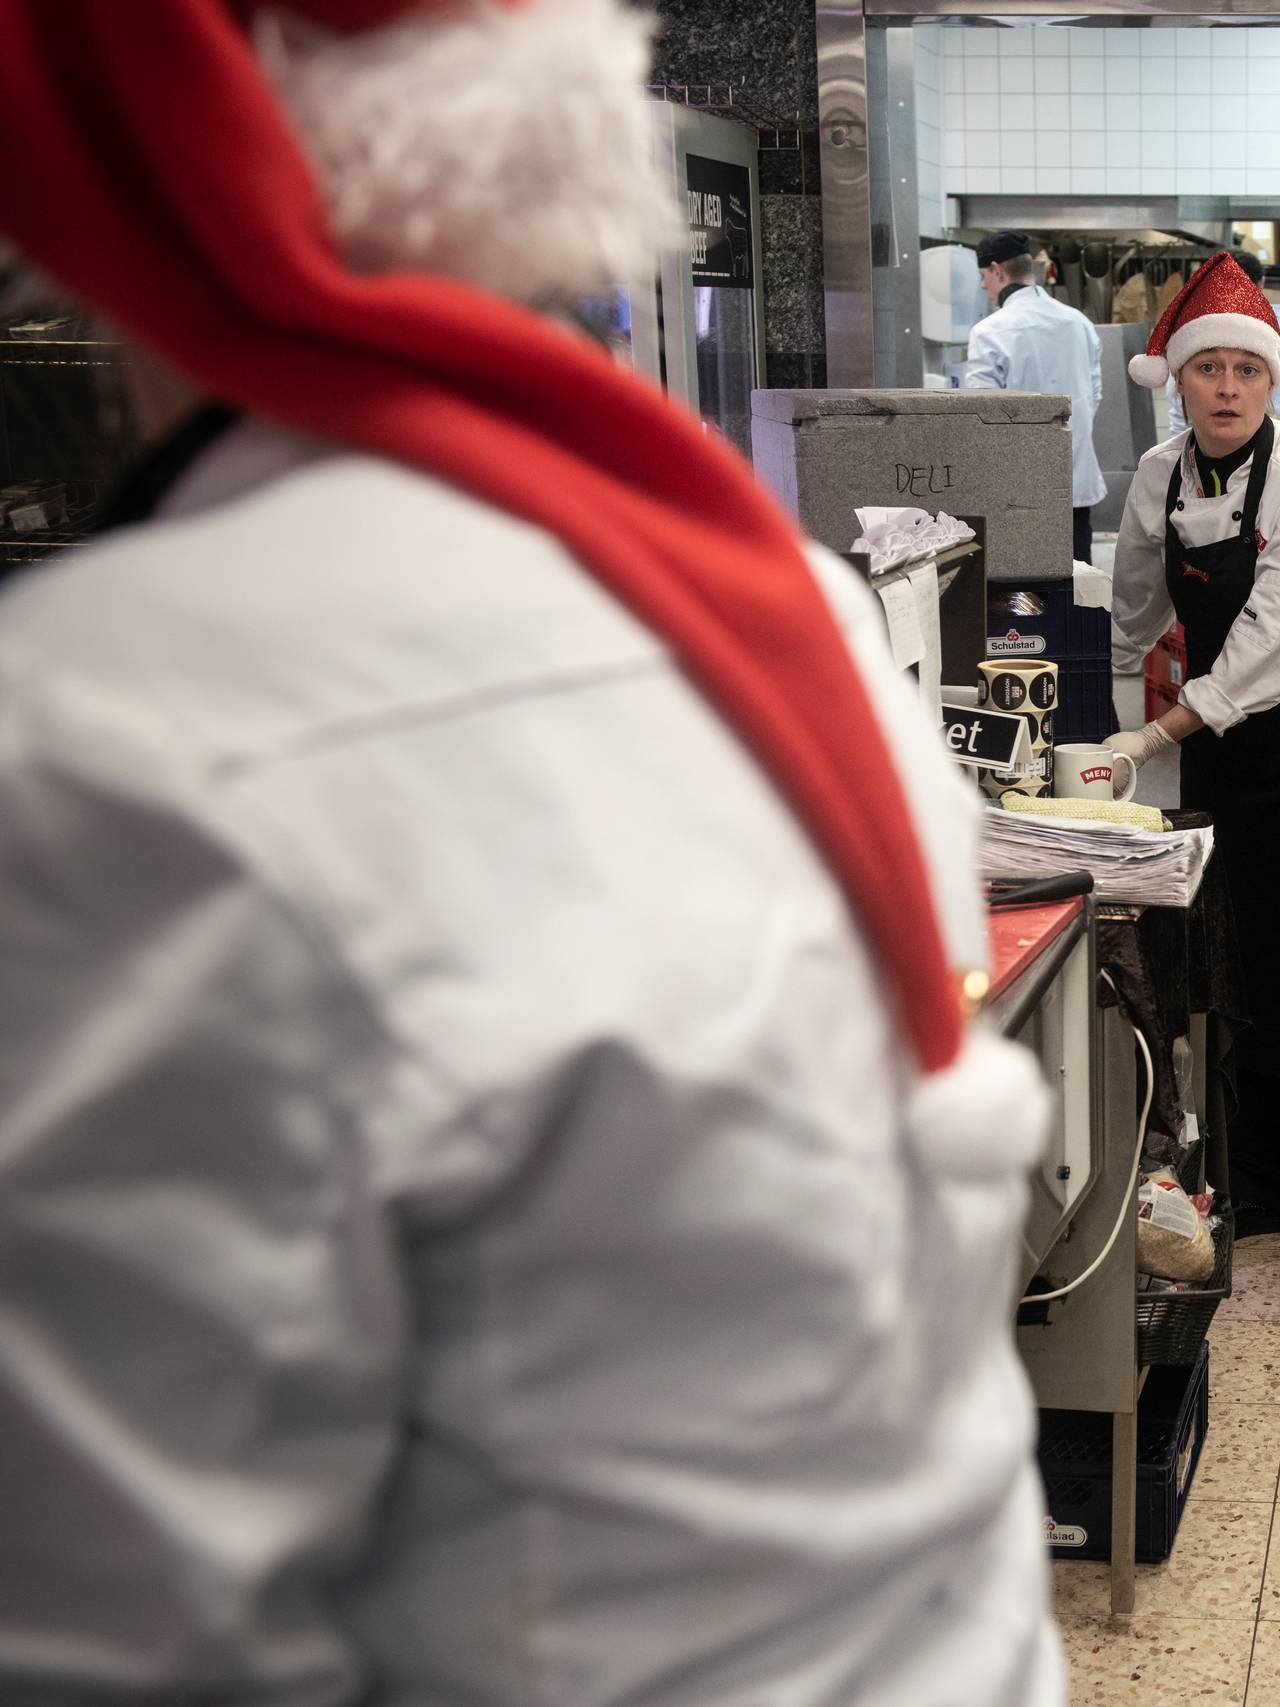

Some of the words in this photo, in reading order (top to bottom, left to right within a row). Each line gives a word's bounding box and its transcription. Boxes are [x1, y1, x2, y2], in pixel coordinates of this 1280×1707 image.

[687, 190, 702, 225] DRY
[703, 193, 722, 228] AGED
[895, 463, 955, 497] DELI
[991, 641, 1036, 651] Schulstad
[1085, 769, 1111, 781] MENY
